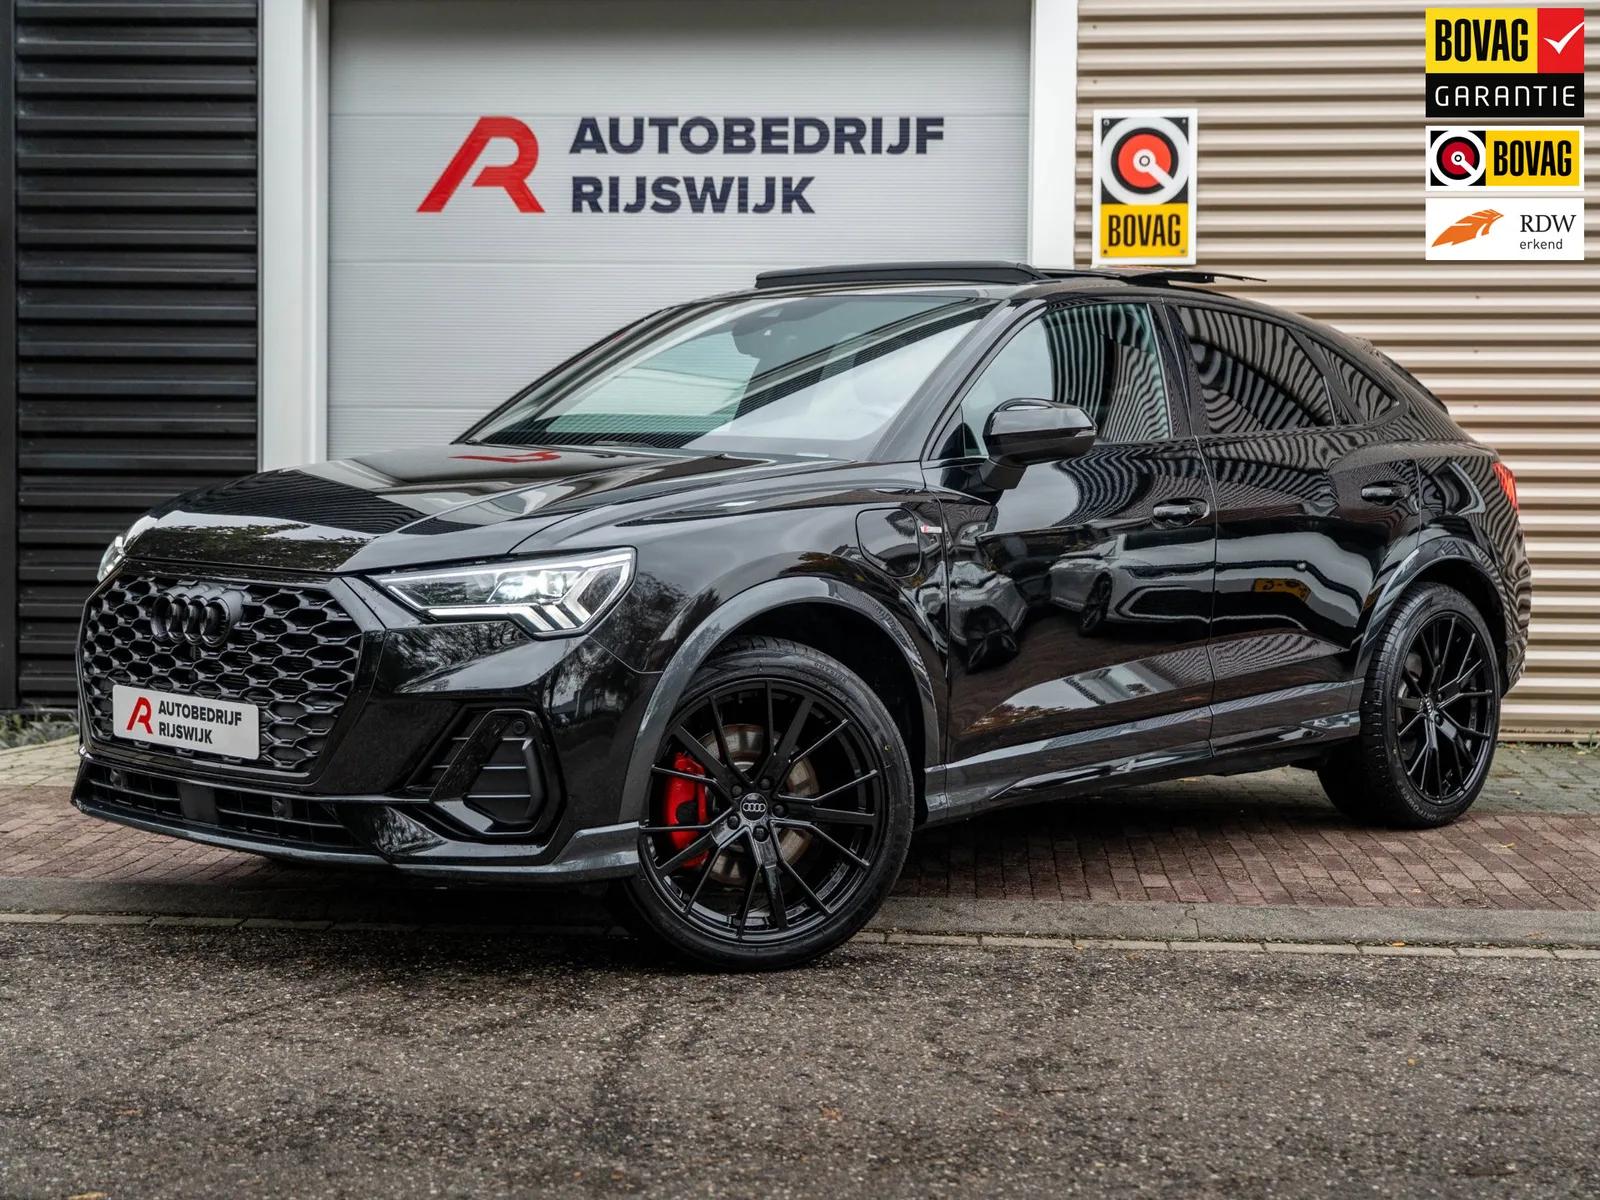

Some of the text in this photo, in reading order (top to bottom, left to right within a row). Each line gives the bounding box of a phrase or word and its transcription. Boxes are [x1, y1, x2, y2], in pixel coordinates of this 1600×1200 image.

[569, 117, 945, 155] AUTOBEDRIJF
[571, 176, 816, 214] RIJSWIJK
[1108, 214, 1181, 247] BOVAG
[158, 700, 242, 727] AUTOBEDRIJF
[159, 721, 213, 744] RIJSWIJK
